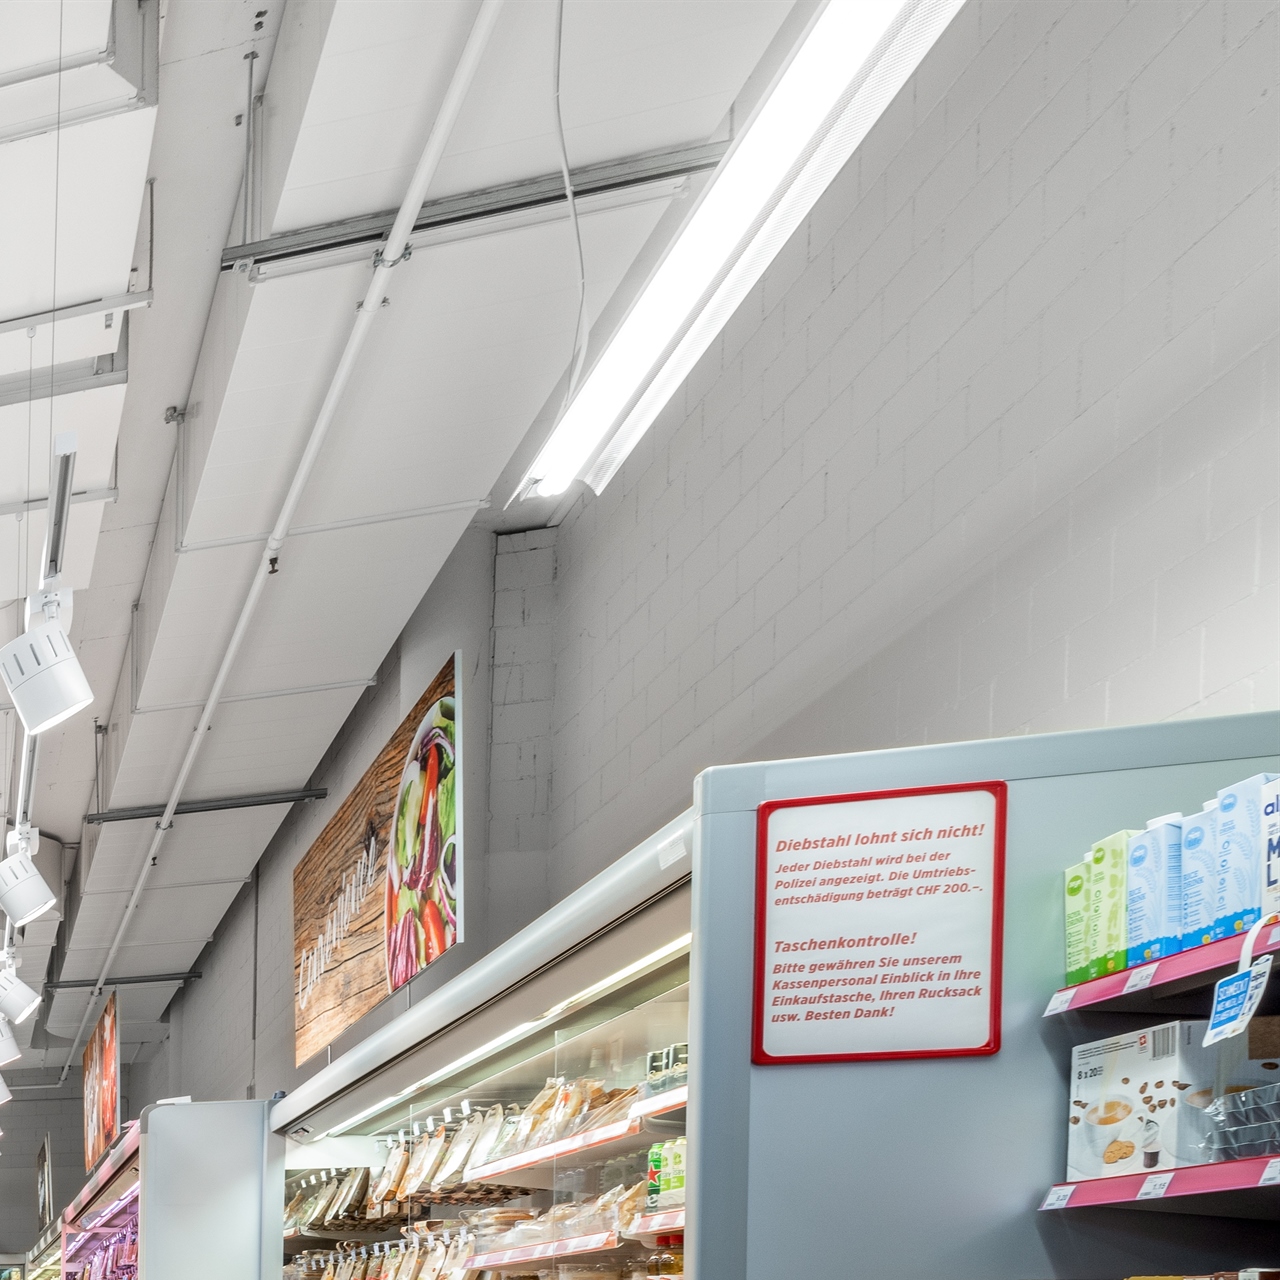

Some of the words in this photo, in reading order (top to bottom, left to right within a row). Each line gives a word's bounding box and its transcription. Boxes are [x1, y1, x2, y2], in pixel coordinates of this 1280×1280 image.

[775, 834, 851, 852] Diebstahl
[855, 831, 897, 846] lohnt
[900, 828, 933, 842] sich
[937, 823, 985, 839] nicht!
[775, 862, 810, 874] Jeder
[813, 856, 873, 871] Diebstahl
[875, 853, 904, 866] wird
[906, 851, 927, 863] bei
[929, 851, 951, 862] der
[774, 877, 817, 890] Polizei
[819, 872, 884, 887] angezeigt.
[888, 870, 909, 881] Die
[912, 866, 976, 880] Umtriebs-
[774, 890, 864, 906] entschädigung
[866, 886, 913, 900] beträgt
[915, 884, 940, 895] CHF
[774, 932, 917, 953] Taschenkontrolle!
[772, 962, 806, 975] Bitte
[808, 958, 876, 973] gewähren
[878, 957, 900, 968] Sie
[902, 953, 962, 967] unserem
[772, 974, 877, 991] Kassenpersonal
[880, 971, 934, 984] Einblick
[937, 970, 951, 981] in
[953, 969, 981, 981] Ihre
[771, 991, 876, 1007] Einkaufstasche,
[879, 990, 915, 1001] Ihren
[918, 985, 982, 999] Rucksack
[771, 1012, 801, 1023] usw.
[804, 1008, 851, 1021] Besten
[853, 1006, 895, 1019] Dank!
[1077, 1070, 1083, 1080] 8
[1084, 1071, 1089, 1079] x
[1089, 1068, 1098, 1078] 20
